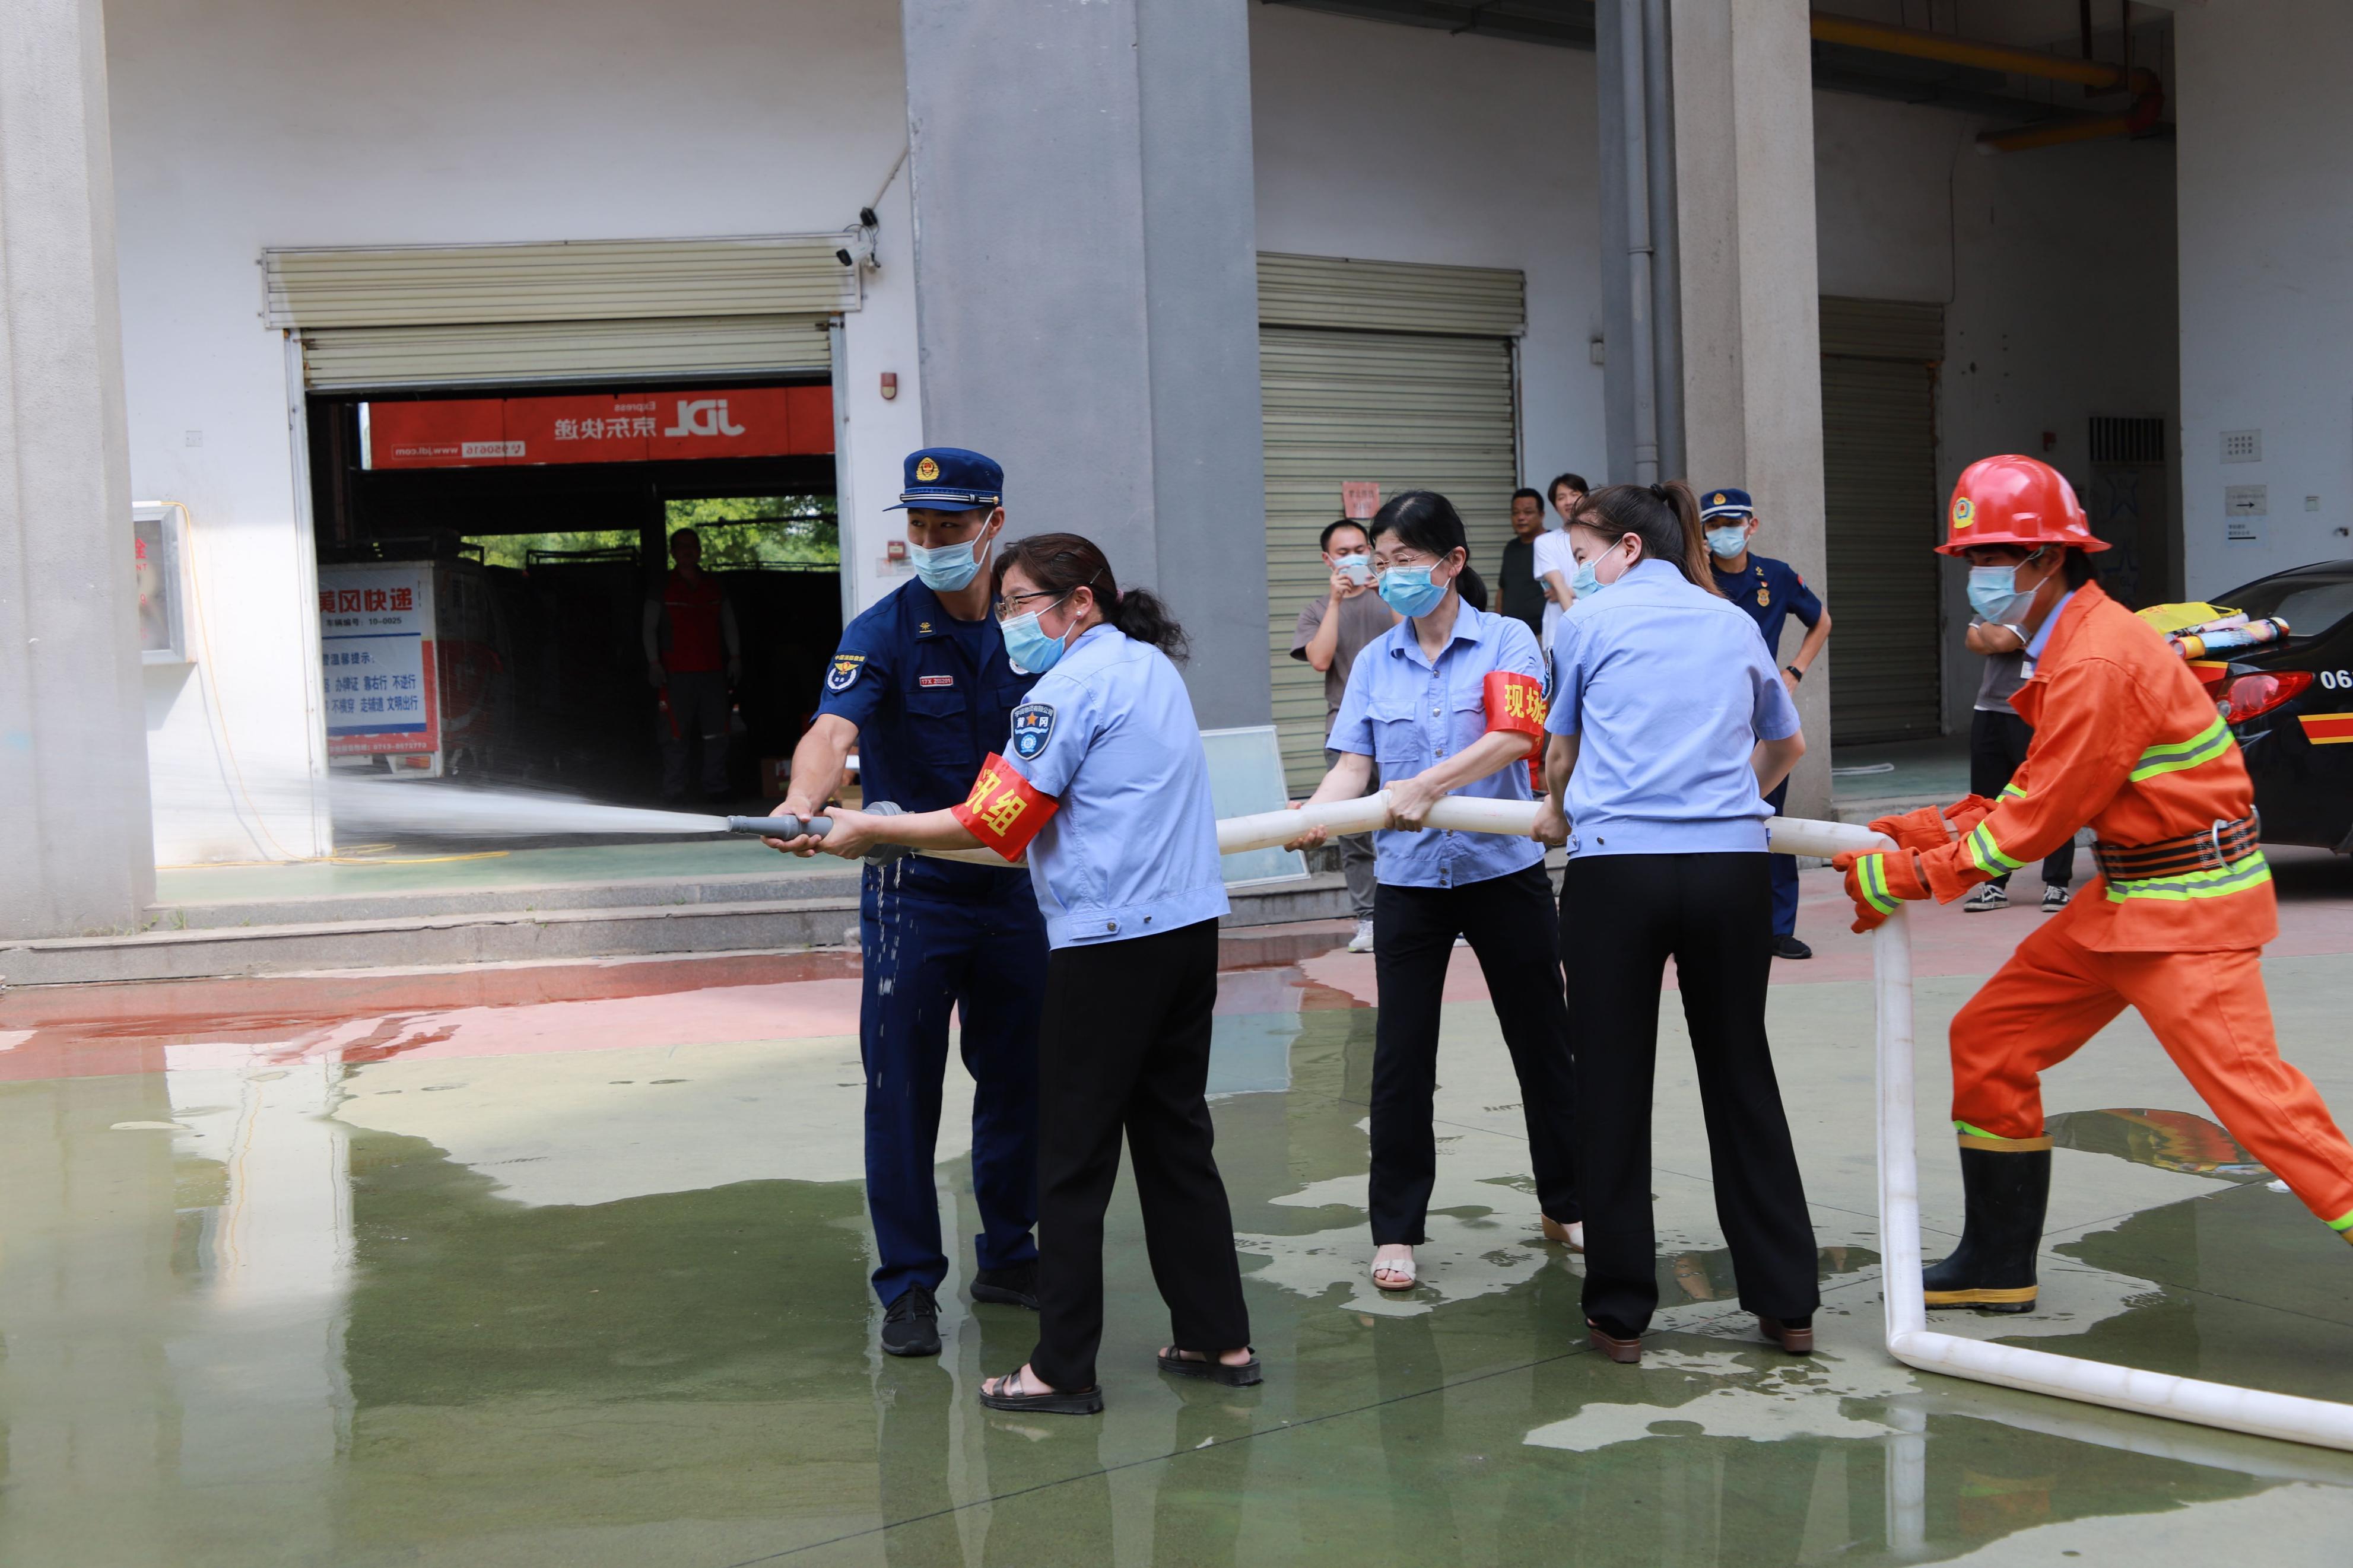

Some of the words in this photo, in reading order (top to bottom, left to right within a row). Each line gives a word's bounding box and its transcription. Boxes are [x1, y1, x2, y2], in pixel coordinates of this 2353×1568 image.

[319, 588, 412, 614] 黄冈快递
[2320, 670, 2353, 689] 06
[387, 695, 418, 712] 文明出行
[1504, 684, 1547, 725] 现场
